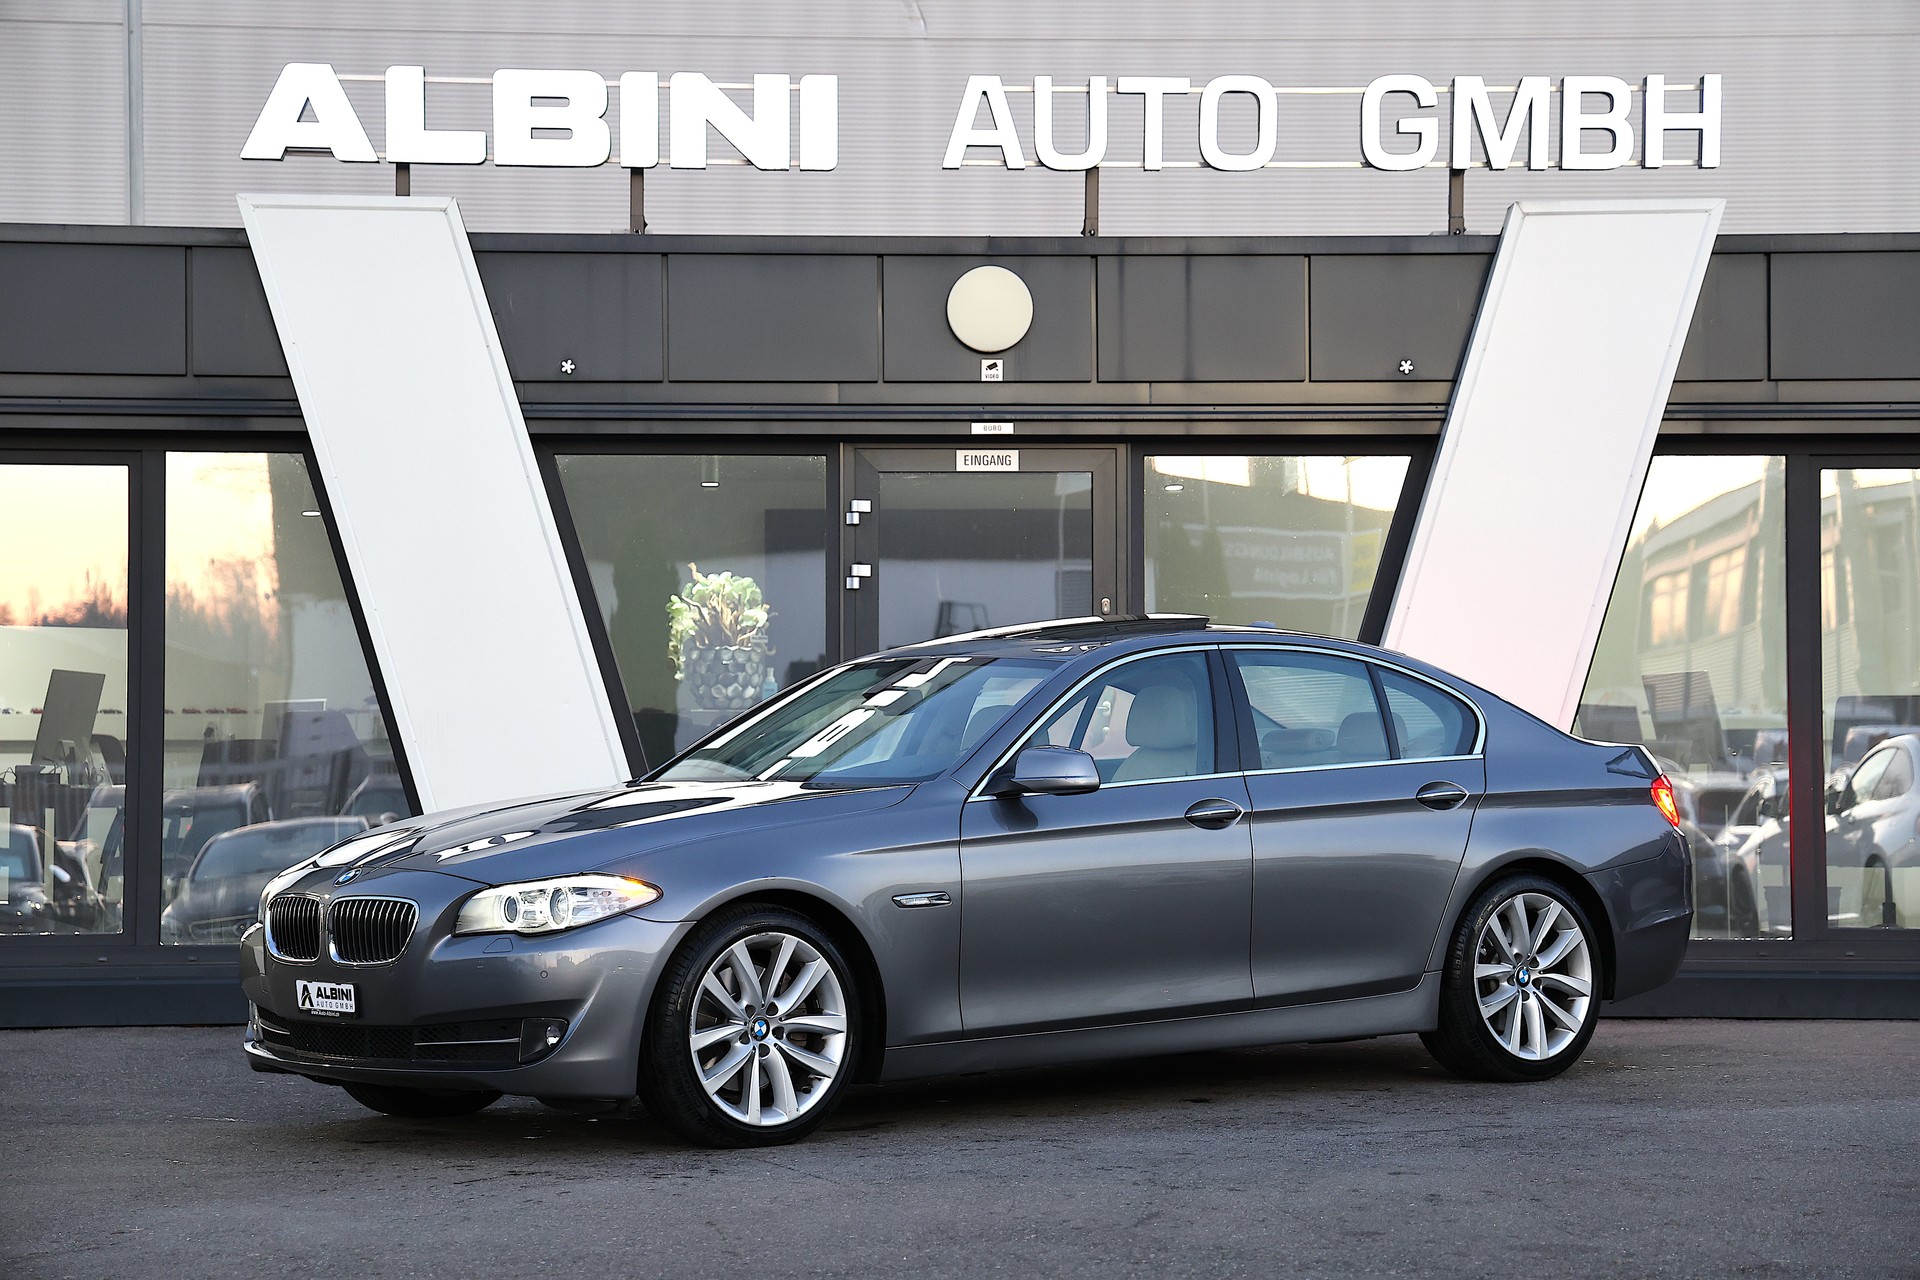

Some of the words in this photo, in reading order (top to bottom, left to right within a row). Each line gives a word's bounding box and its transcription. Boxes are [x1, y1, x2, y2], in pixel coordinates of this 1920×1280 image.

[240, 62, 839, 171] ALBINI
[942, 75, 1278, 171] AUTO
[1361, 73, 1722, 171] GMBH
[963, 454, 1012, 466] EINGANG
[316, 986, 352, 1001] ALBINI
[316, 1000, 333, 1009] AUTO
[335, 1002, 353, 1010] GMBH
